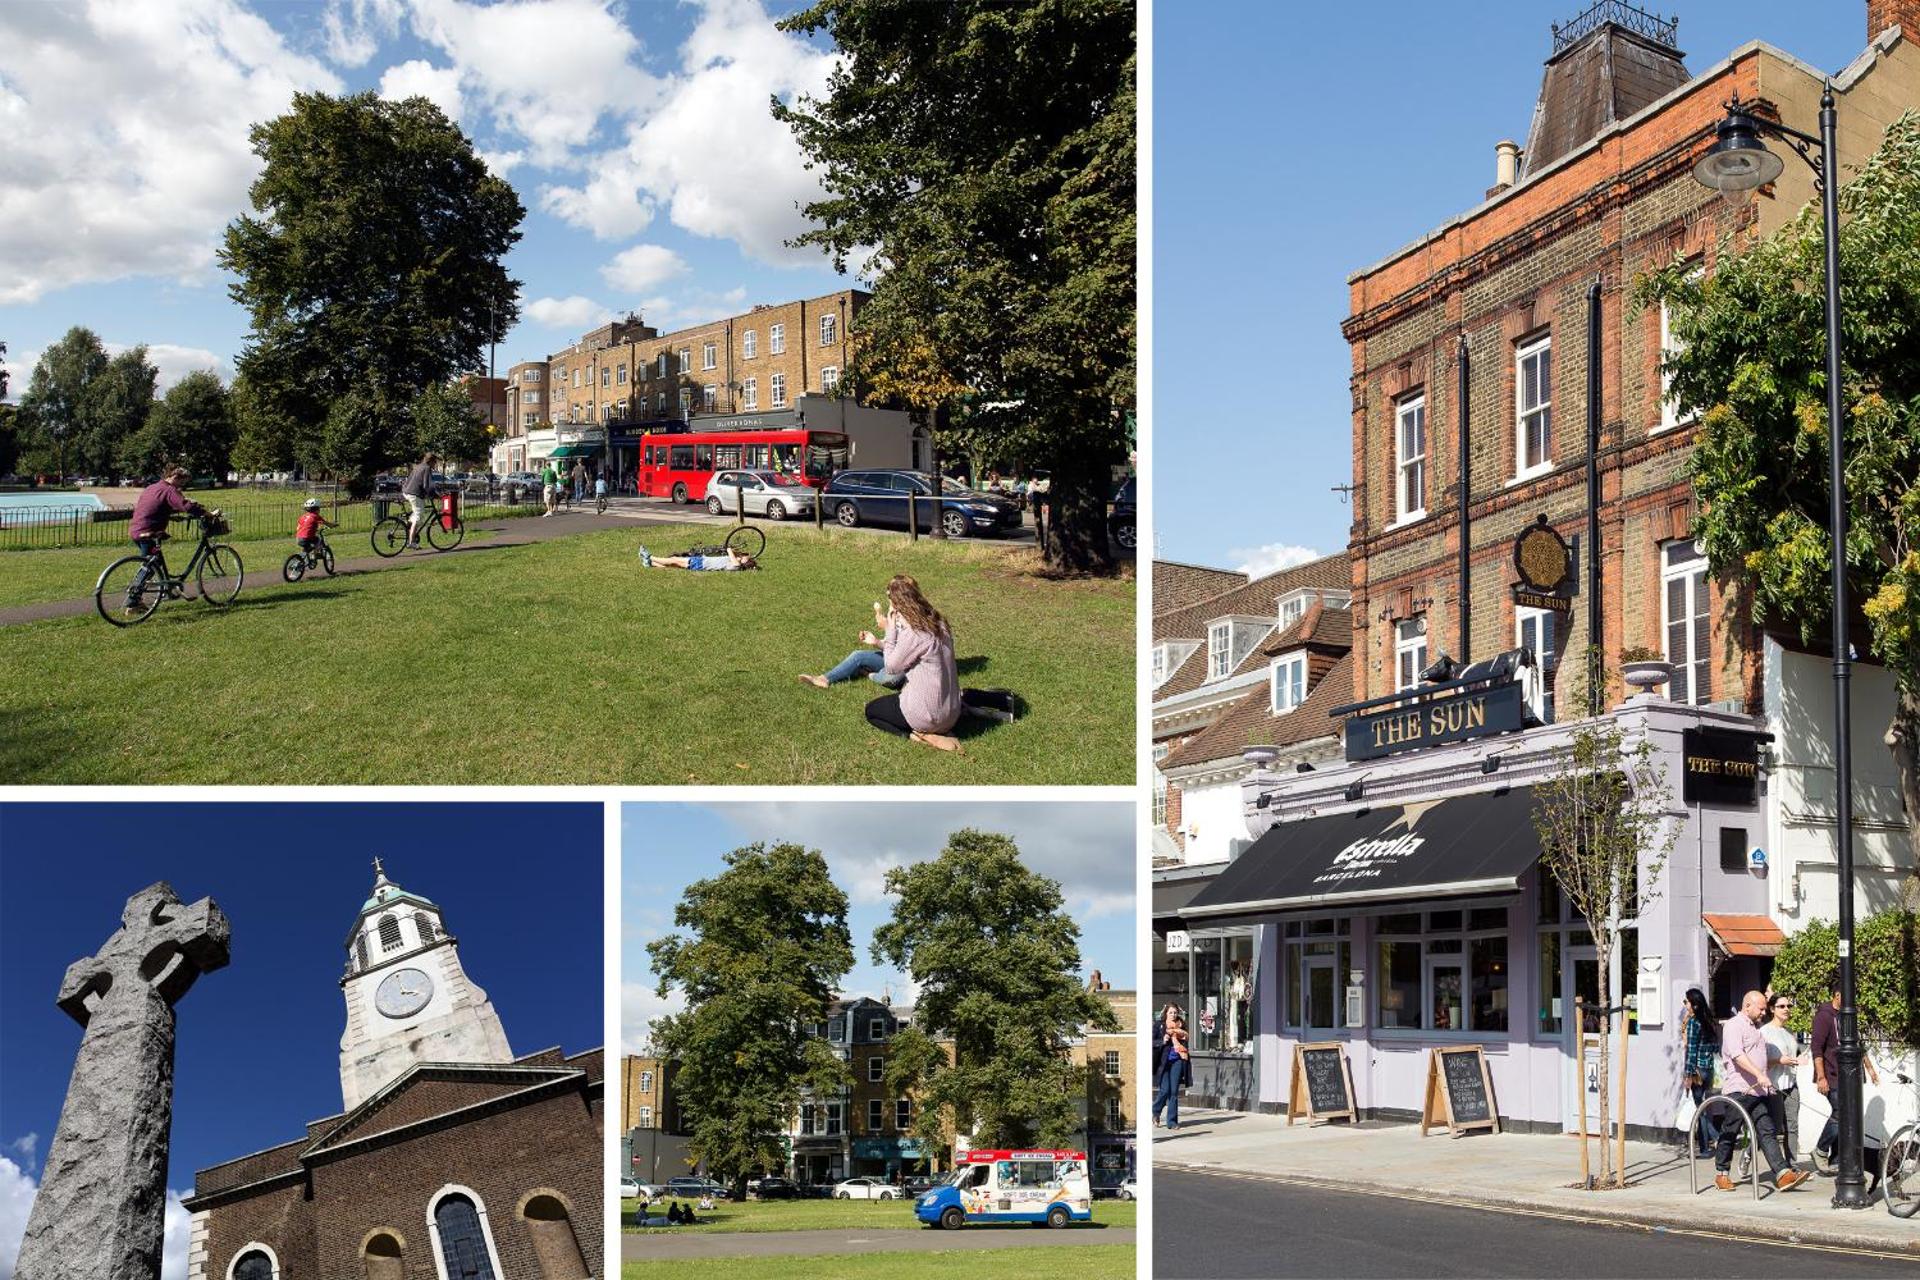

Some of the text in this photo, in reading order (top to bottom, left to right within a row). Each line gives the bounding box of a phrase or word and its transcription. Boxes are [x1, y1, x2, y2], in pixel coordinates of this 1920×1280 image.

[1518, 593, 1566, 609] THE SUN
[1371, 697, 1486, 748] THE SUN
[1688, 757, 1757, 777] THE SUN
[1333, 832, 1426, 864] Estrella
[1313, 869, 1382, 883] BARCELONA
